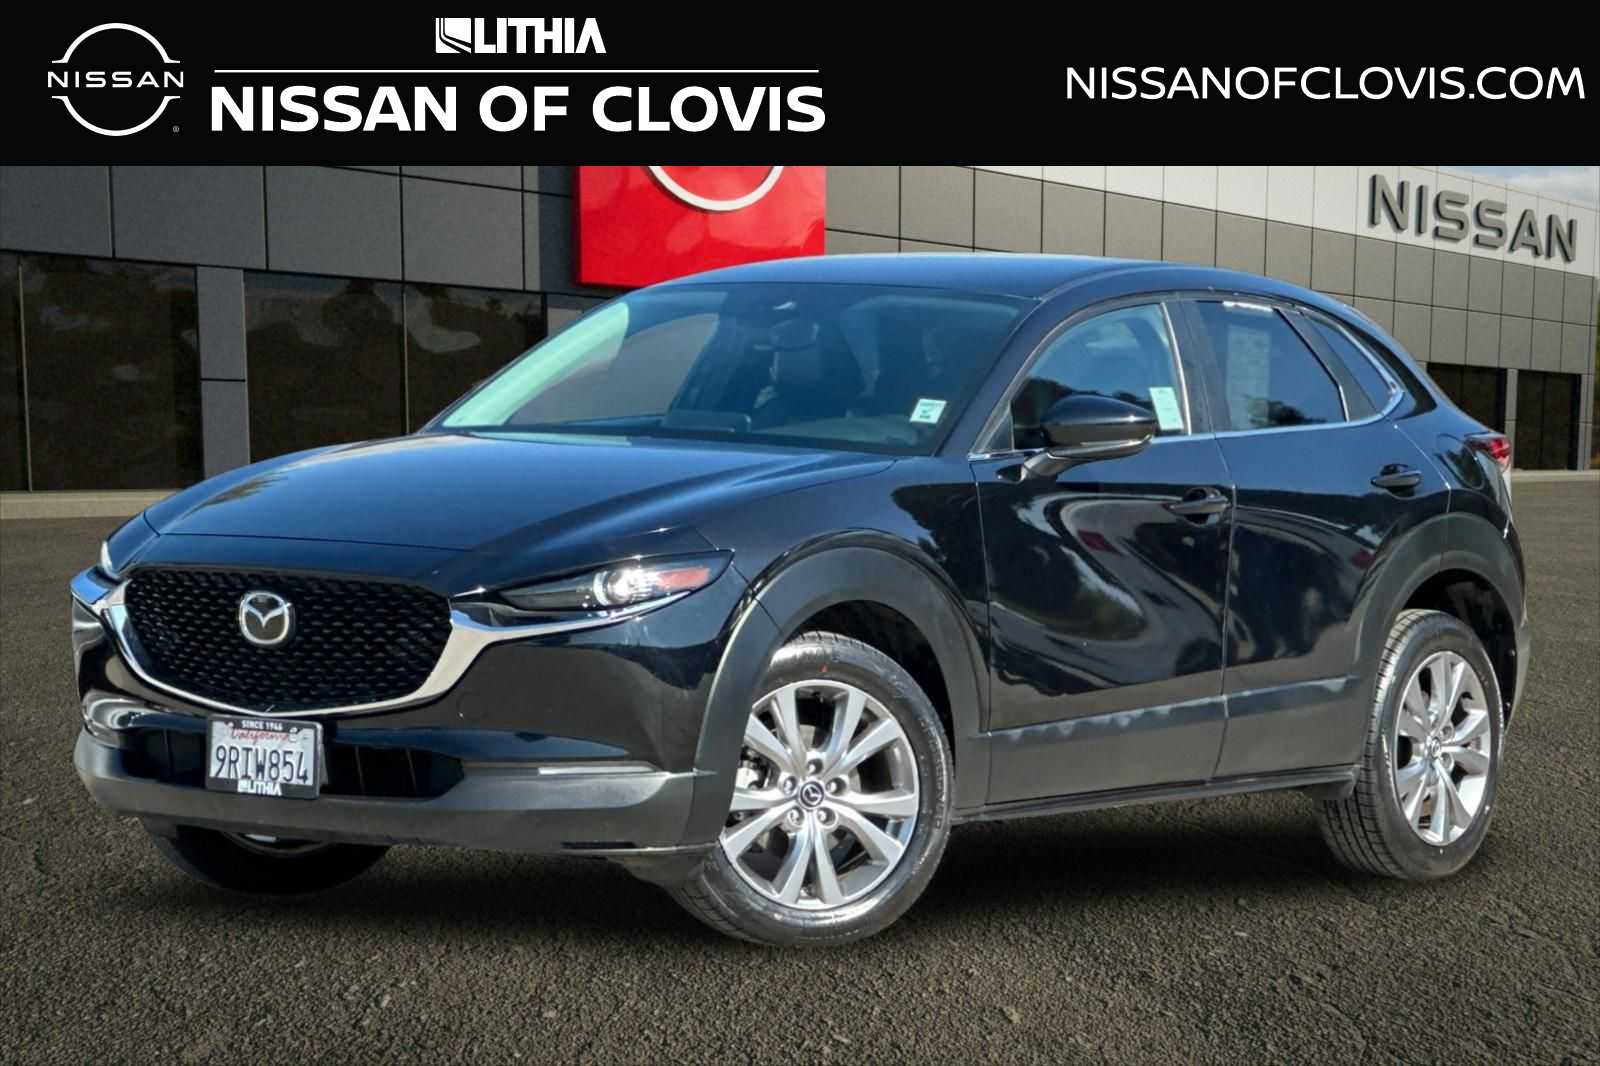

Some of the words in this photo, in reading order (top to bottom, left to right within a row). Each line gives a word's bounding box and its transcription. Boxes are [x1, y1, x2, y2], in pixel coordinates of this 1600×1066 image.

[1368, 173, 1578, 264] NISSAN
[215, 745, 308, 784] 9RIW854
[248, 779, 282, 797] LITHIA
